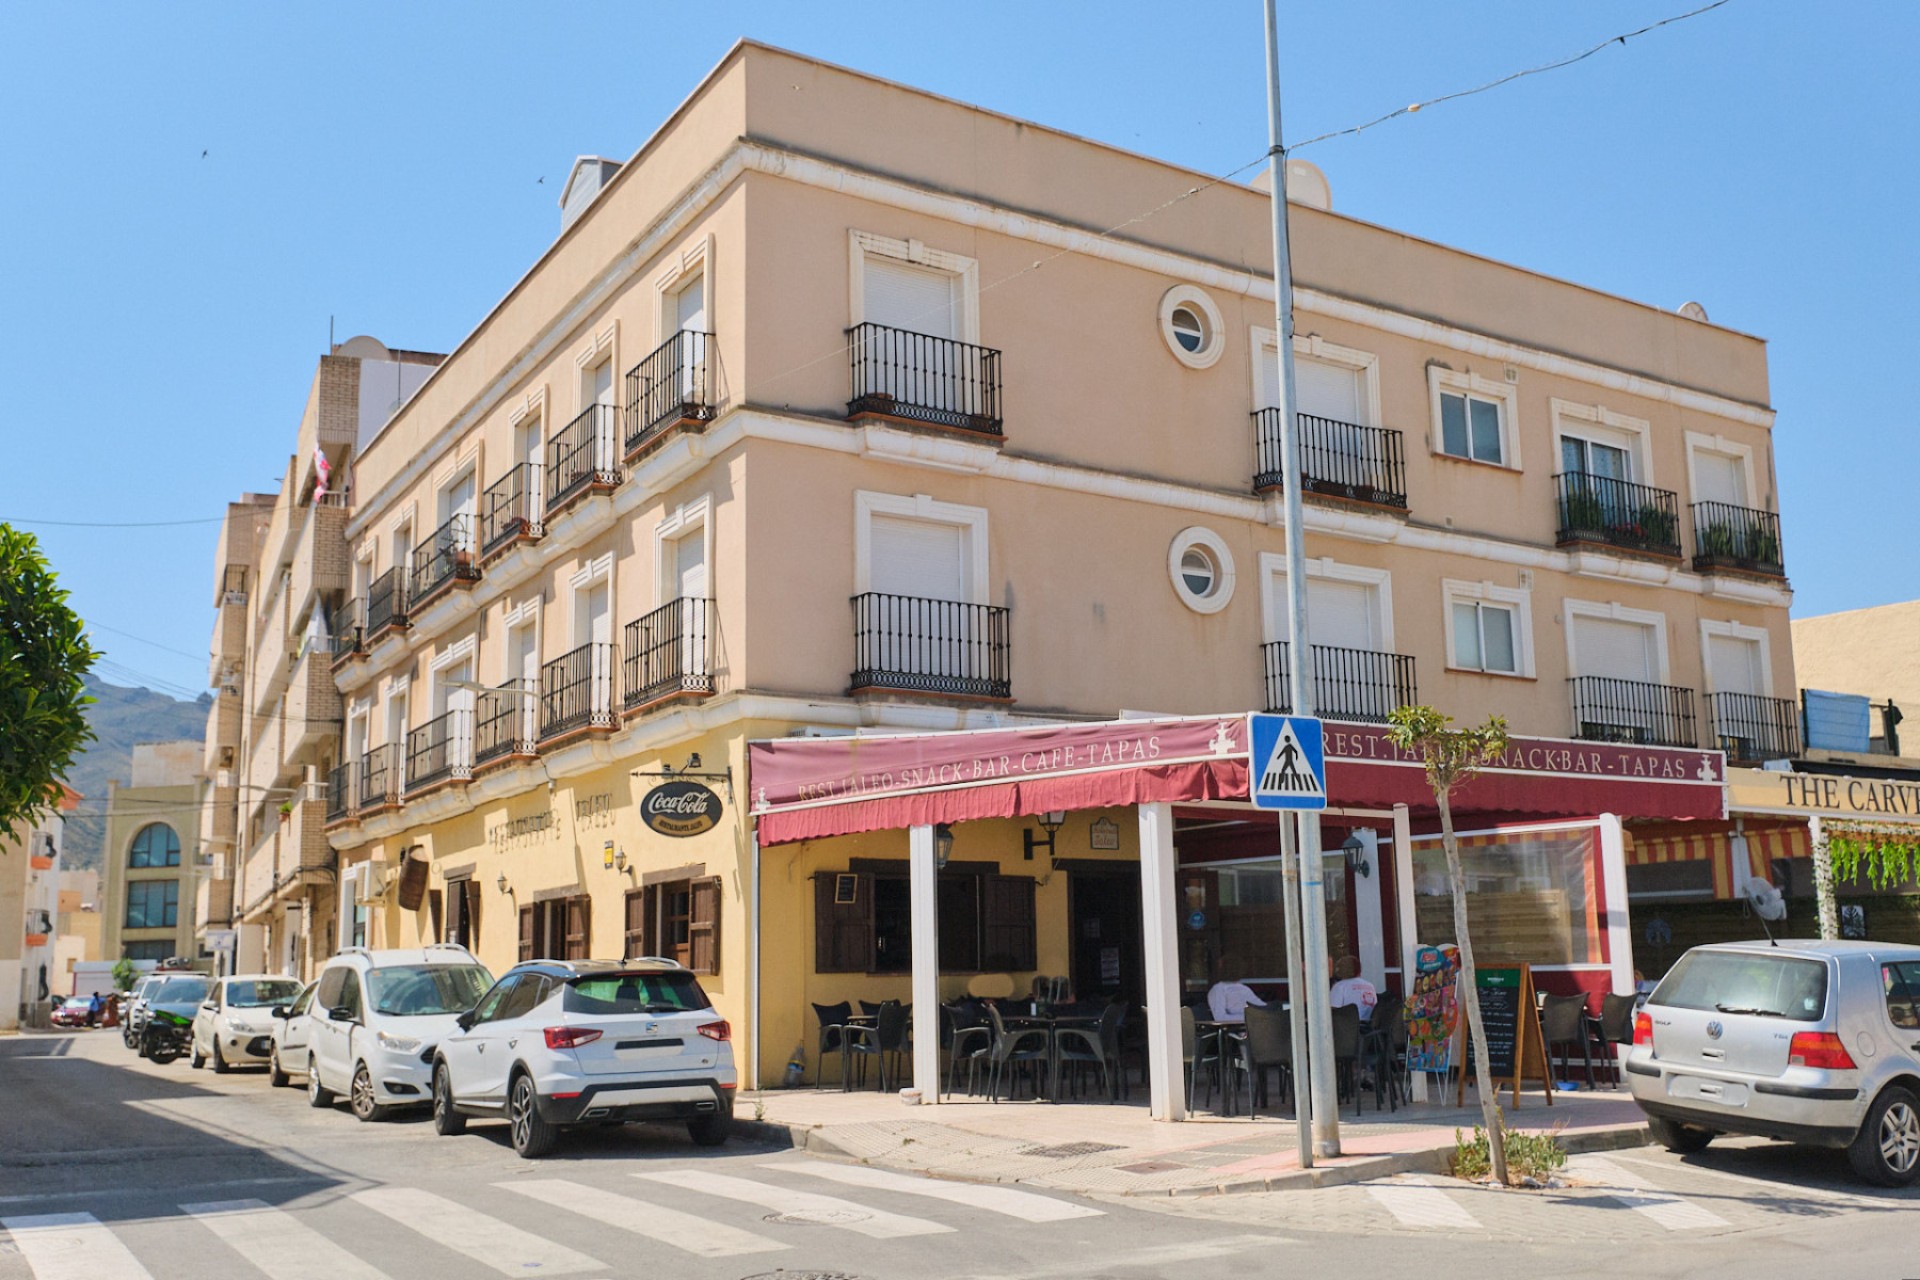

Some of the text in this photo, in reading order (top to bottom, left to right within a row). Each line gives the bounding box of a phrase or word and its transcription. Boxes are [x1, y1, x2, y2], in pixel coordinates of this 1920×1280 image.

[1619, 755, 1686, 778] TAPAS
[648, 792, 711, 813] Coca-Cola
[1780, 775, 1840, 809] THE
